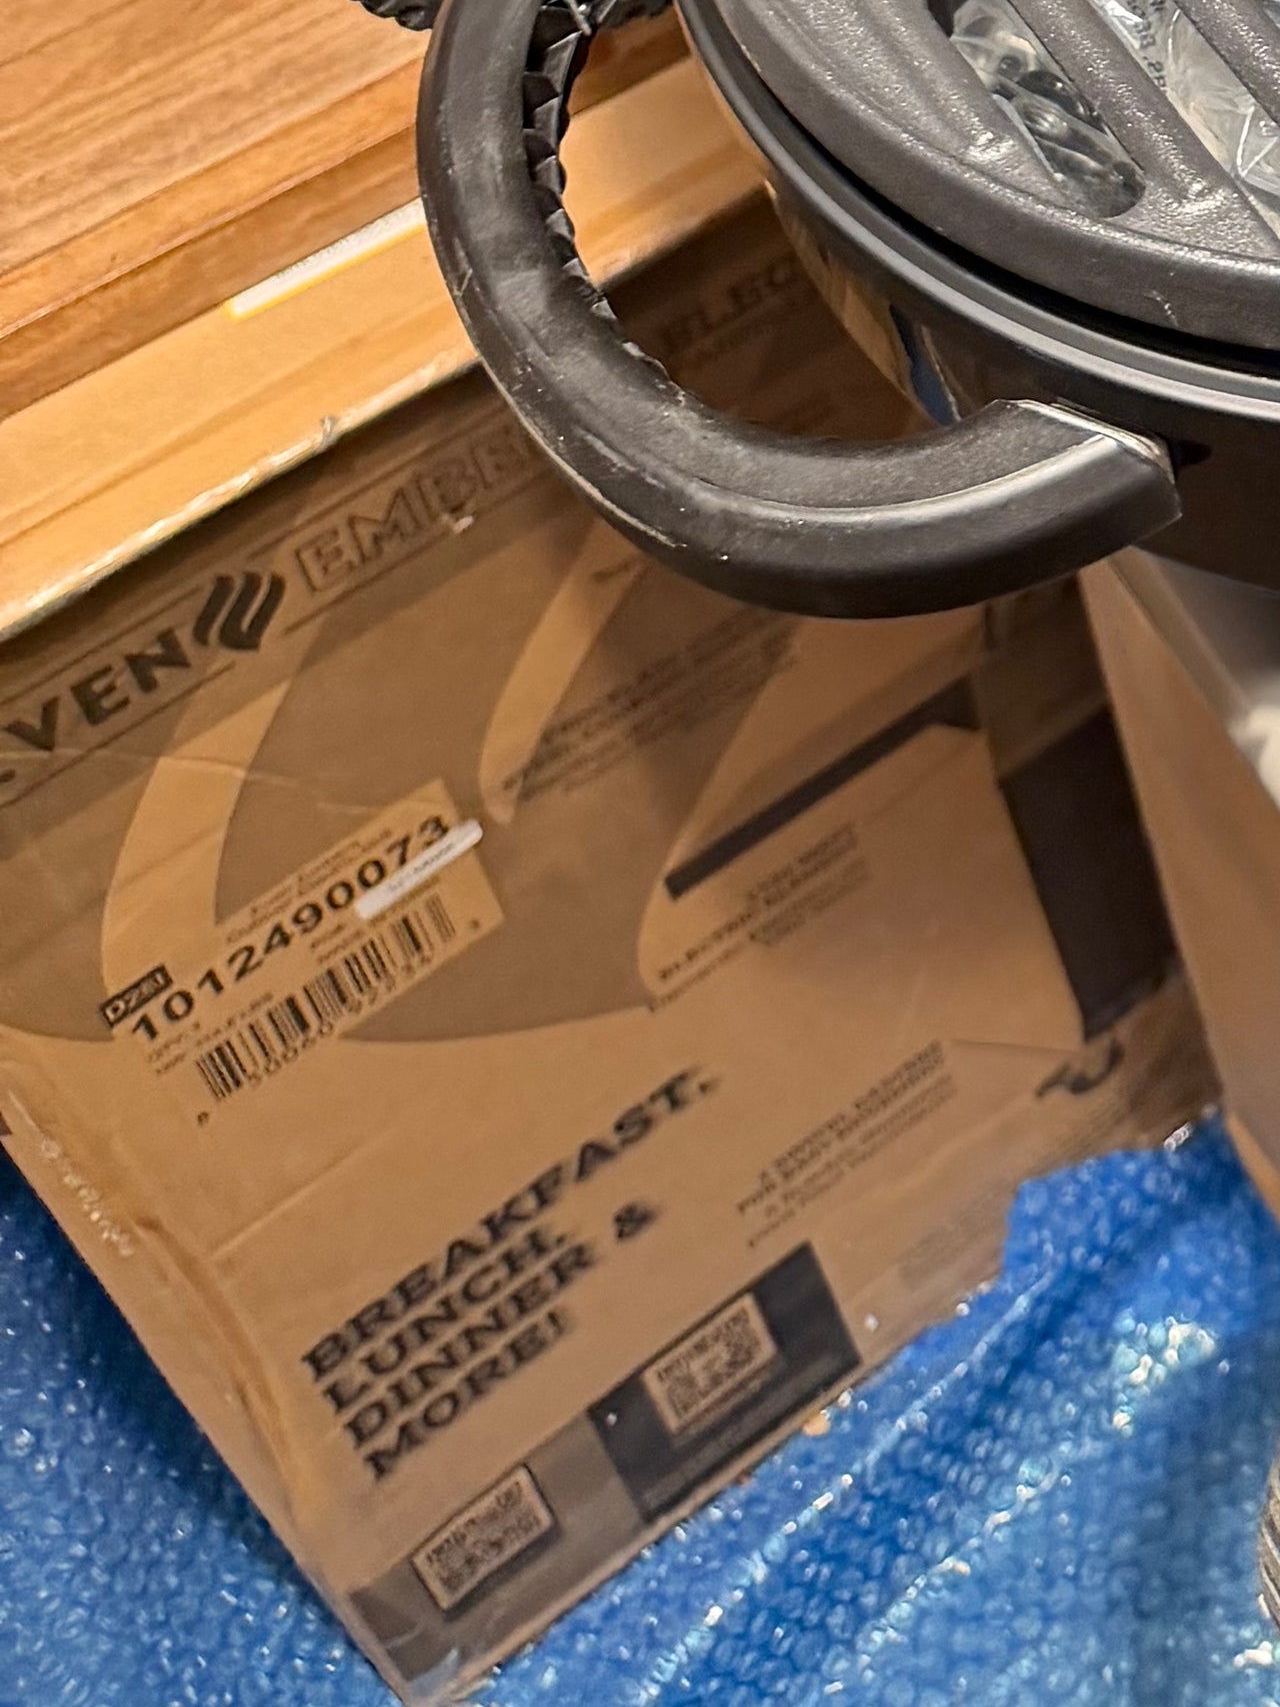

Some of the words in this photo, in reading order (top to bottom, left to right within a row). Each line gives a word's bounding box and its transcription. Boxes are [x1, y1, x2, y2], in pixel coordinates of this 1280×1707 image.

[0, 628, 190, 777] VEN
[131, 814, 450, 1042] 1012490073
[343, 1241, 597, 1449] DINNER
